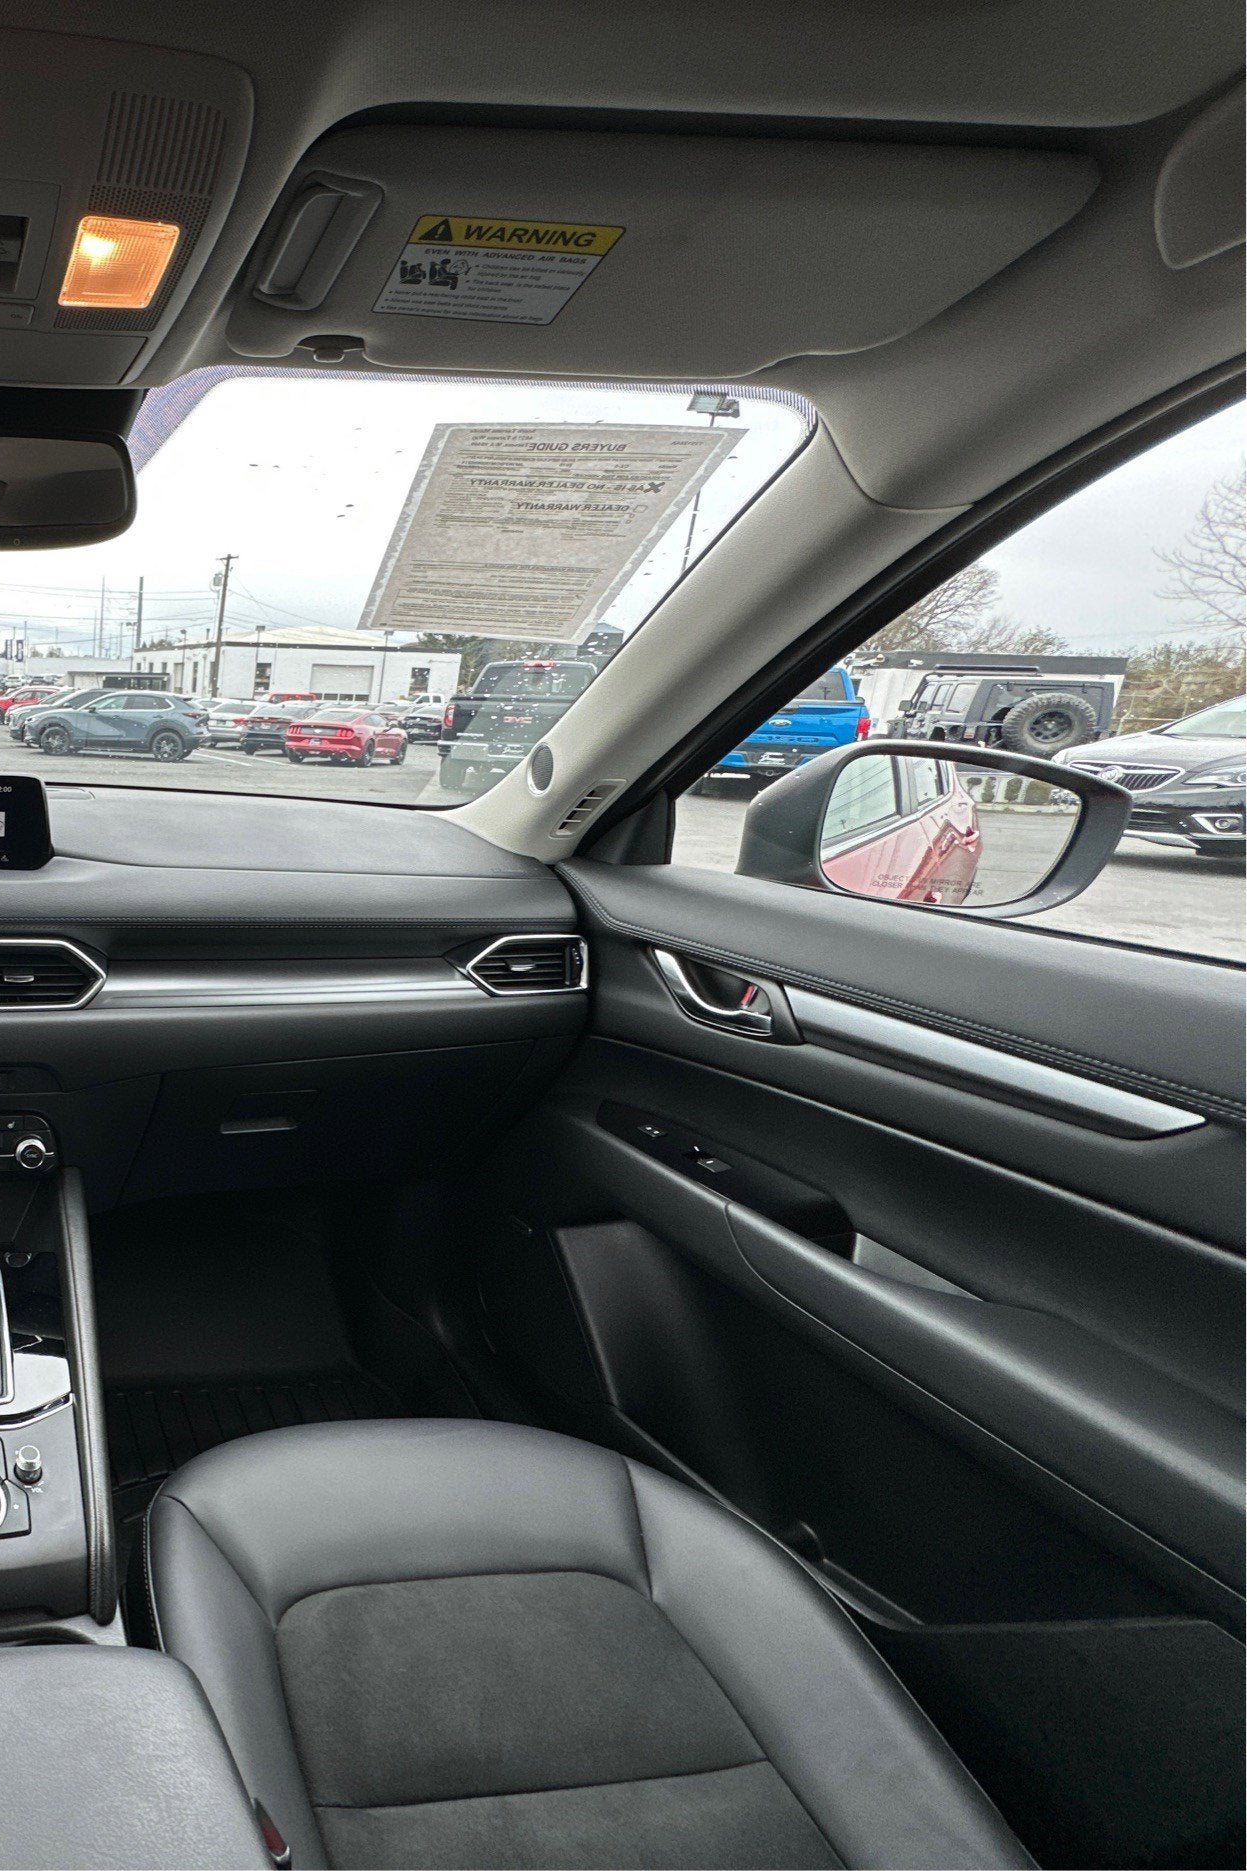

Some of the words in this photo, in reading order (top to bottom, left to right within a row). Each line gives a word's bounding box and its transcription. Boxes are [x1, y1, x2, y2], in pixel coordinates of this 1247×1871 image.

[460, 224, 599, 247] WARNING
[481, 251, 535, 260] ADVANCED
[503, 716, 533, 724] GMC
[878, 873, 912, 883] OBJECT
[872, 881, 903, 889] CLOSER
[31, 1486, 43, 1494] VOL
